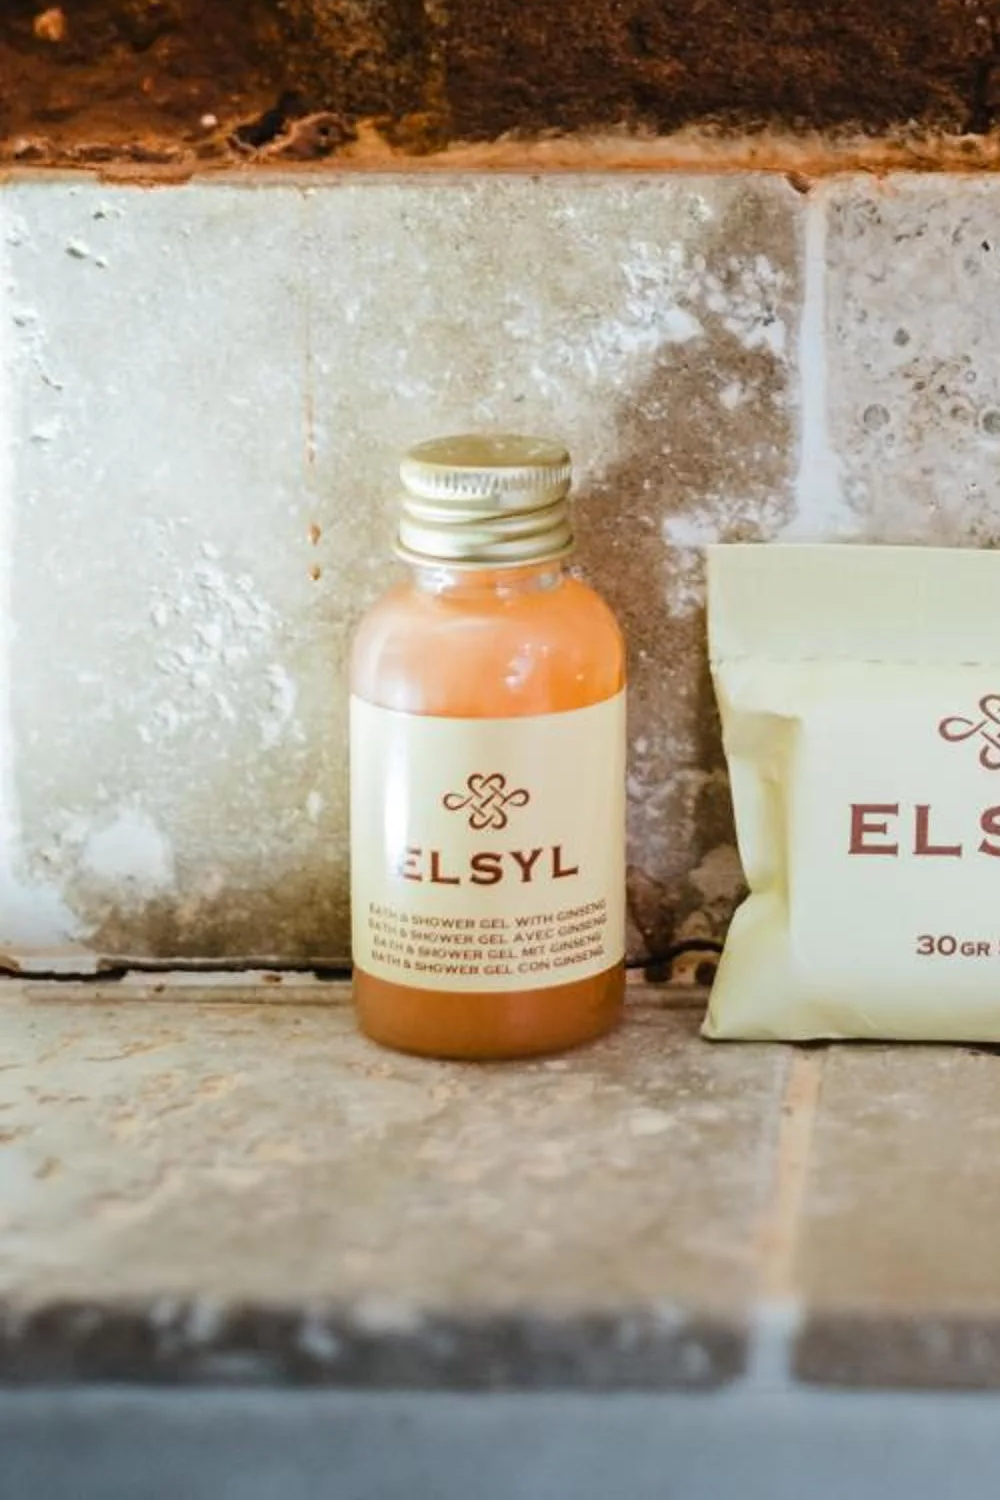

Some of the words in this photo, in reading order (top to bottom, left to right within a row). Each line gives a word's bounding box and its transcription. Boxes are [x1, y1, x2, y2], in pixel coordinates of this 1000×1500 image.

[398, 845, 579, 886] ELSYL
[411, 916, 475, 929] SHOWER
[480, 919, 510, 929] GEL
[515, 914, 553, 927] WITH
[556, 899, 606, 921] GINSENG
[411, 931, 474, 945] SHOWER
[478, 934, 508, 945] GEL
[513, 928, 556, 942] AVEC
[557, 914, 607, 936] GINSENG
[417, 947, 482, 959] SHOWER
[487, 948, 517, 959] GEL
[521, 946, 547, 957] MIT
[549, 932, 602, 953] GINSENG
[916, 935, 990, 957] 30GR
[414, 962, 479, 975] SHOWER
[483, 964, 513, 975] GEL
[518, 961, 551, 973] CON
[553, 947, 604, 968] GINSENG
